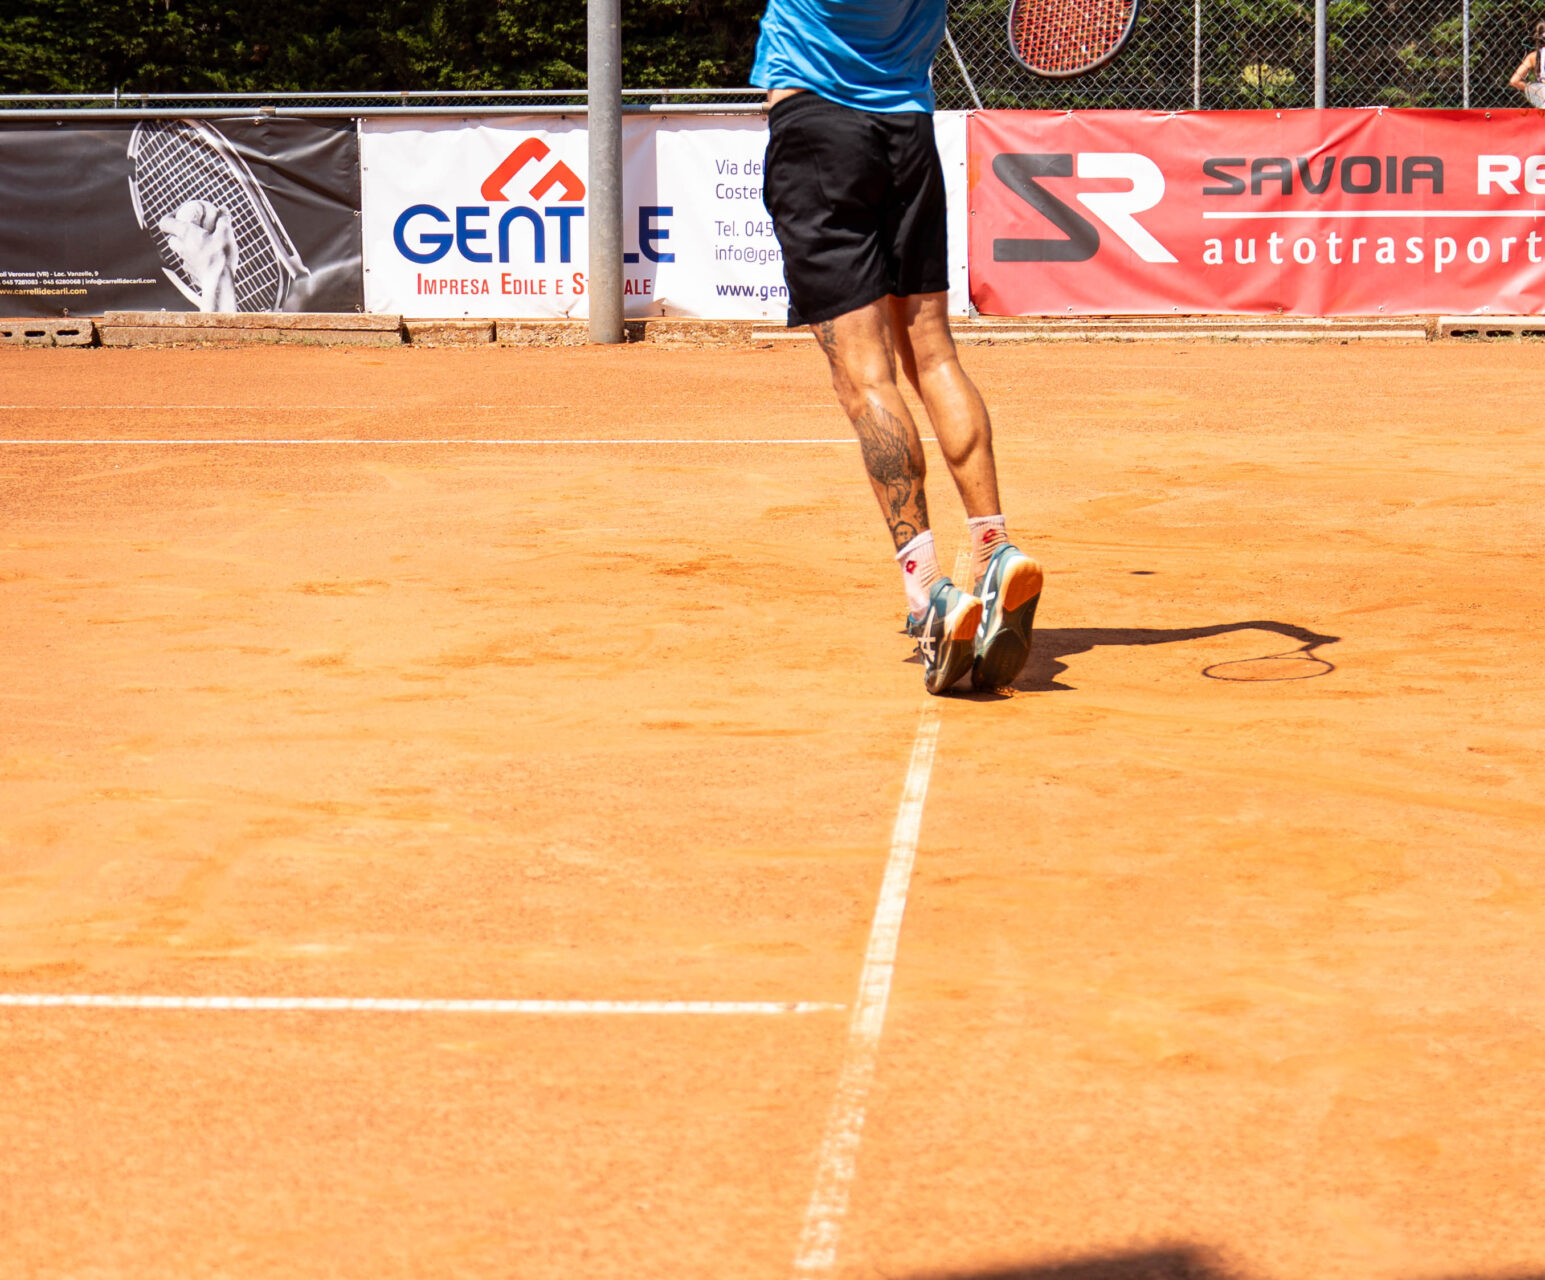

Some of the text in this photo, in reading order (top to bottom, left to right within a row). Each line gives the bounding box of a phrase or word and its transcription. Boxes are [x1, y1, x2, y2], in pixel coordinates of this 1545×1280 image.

[715, 159, 738, 176] Via
[1203, 155, 1444, 196] SAVOIA
[393, 204, 675, 264] GENTE
[715, 220, 774, 237] Tel. 045
[1203, 231, 1543, 273] autotrasport
[417, 273, 490, 295] IMPRESA
[501, 272, 547, 295] EDILE
[716, 284, 788, 301] www.gen
